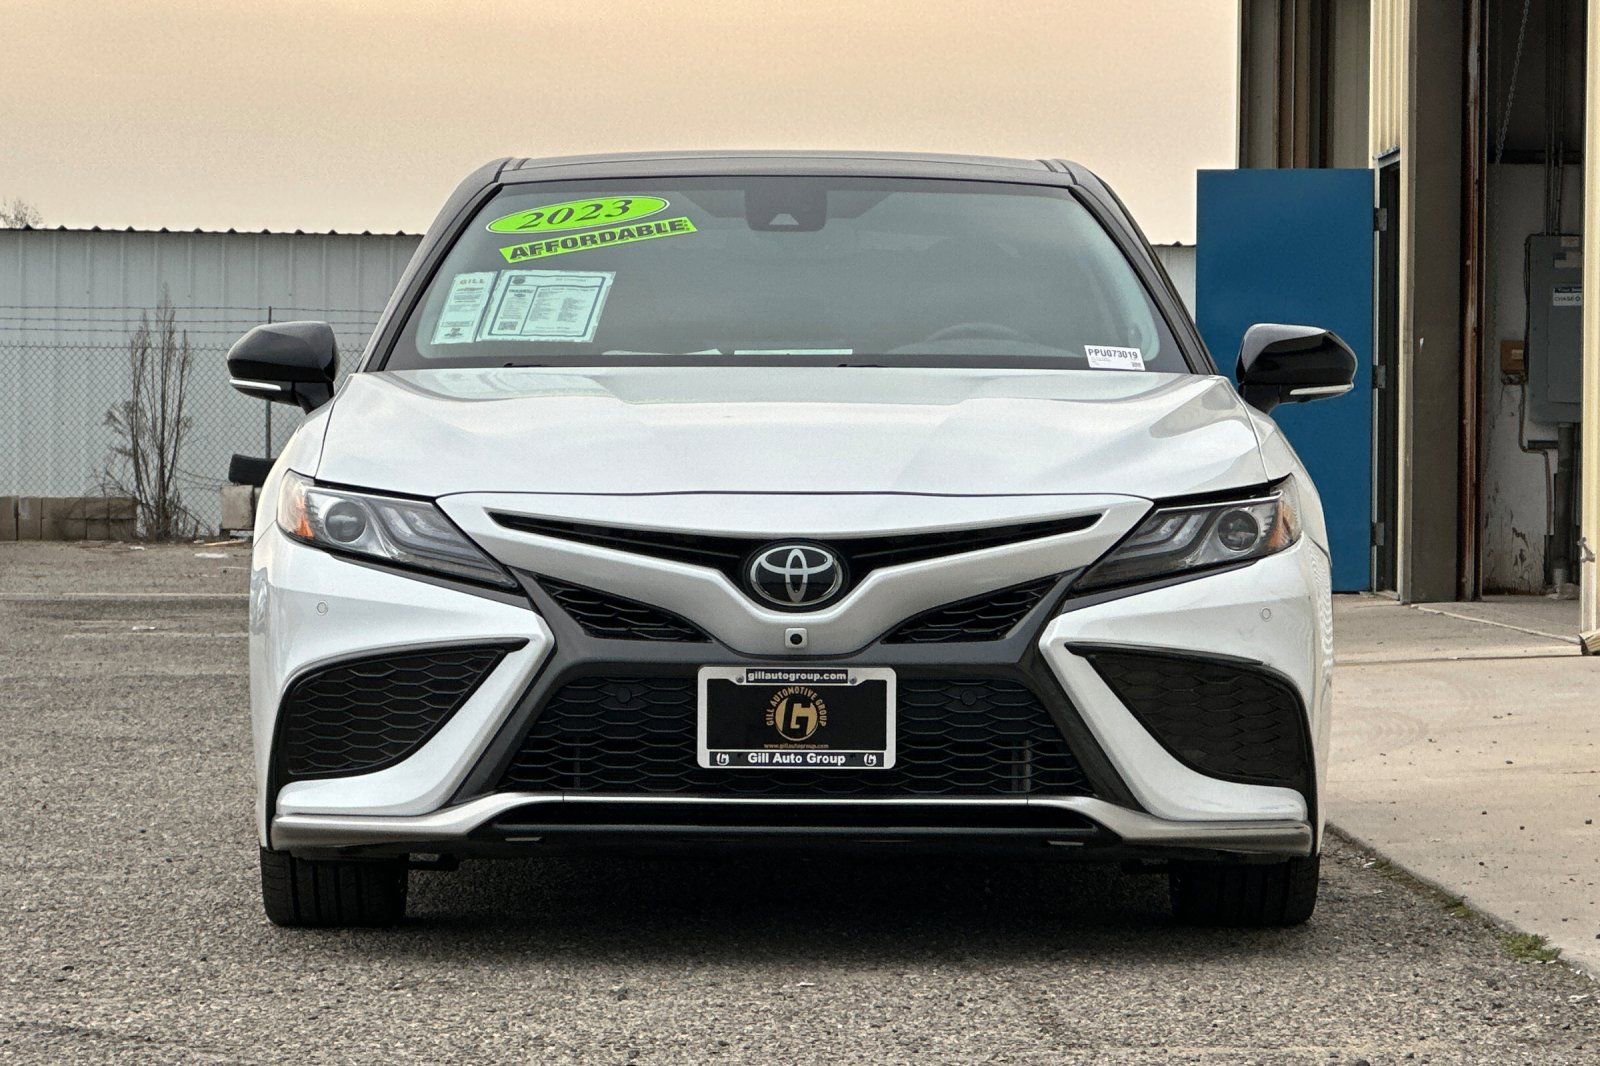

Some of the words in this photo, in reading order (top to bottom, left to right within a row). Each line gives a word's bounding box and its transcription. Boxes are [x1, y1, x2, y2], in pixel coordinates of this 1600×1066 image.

[516, 199, 632, 229] 2023
[509, 219, 688, 260] AFFORDABLE
[747, 672, 847, 682] gillautogroup.com
[765, 708, 775, 726] GILL
[771, 686, 818, 707] AUTOMOTIVE
[814, 699, 828, 727] GROUP
[747, 753, 769, 764] Gill
[772, 753, 803, 764] Auto
[806, 753, 846, 765] Group
